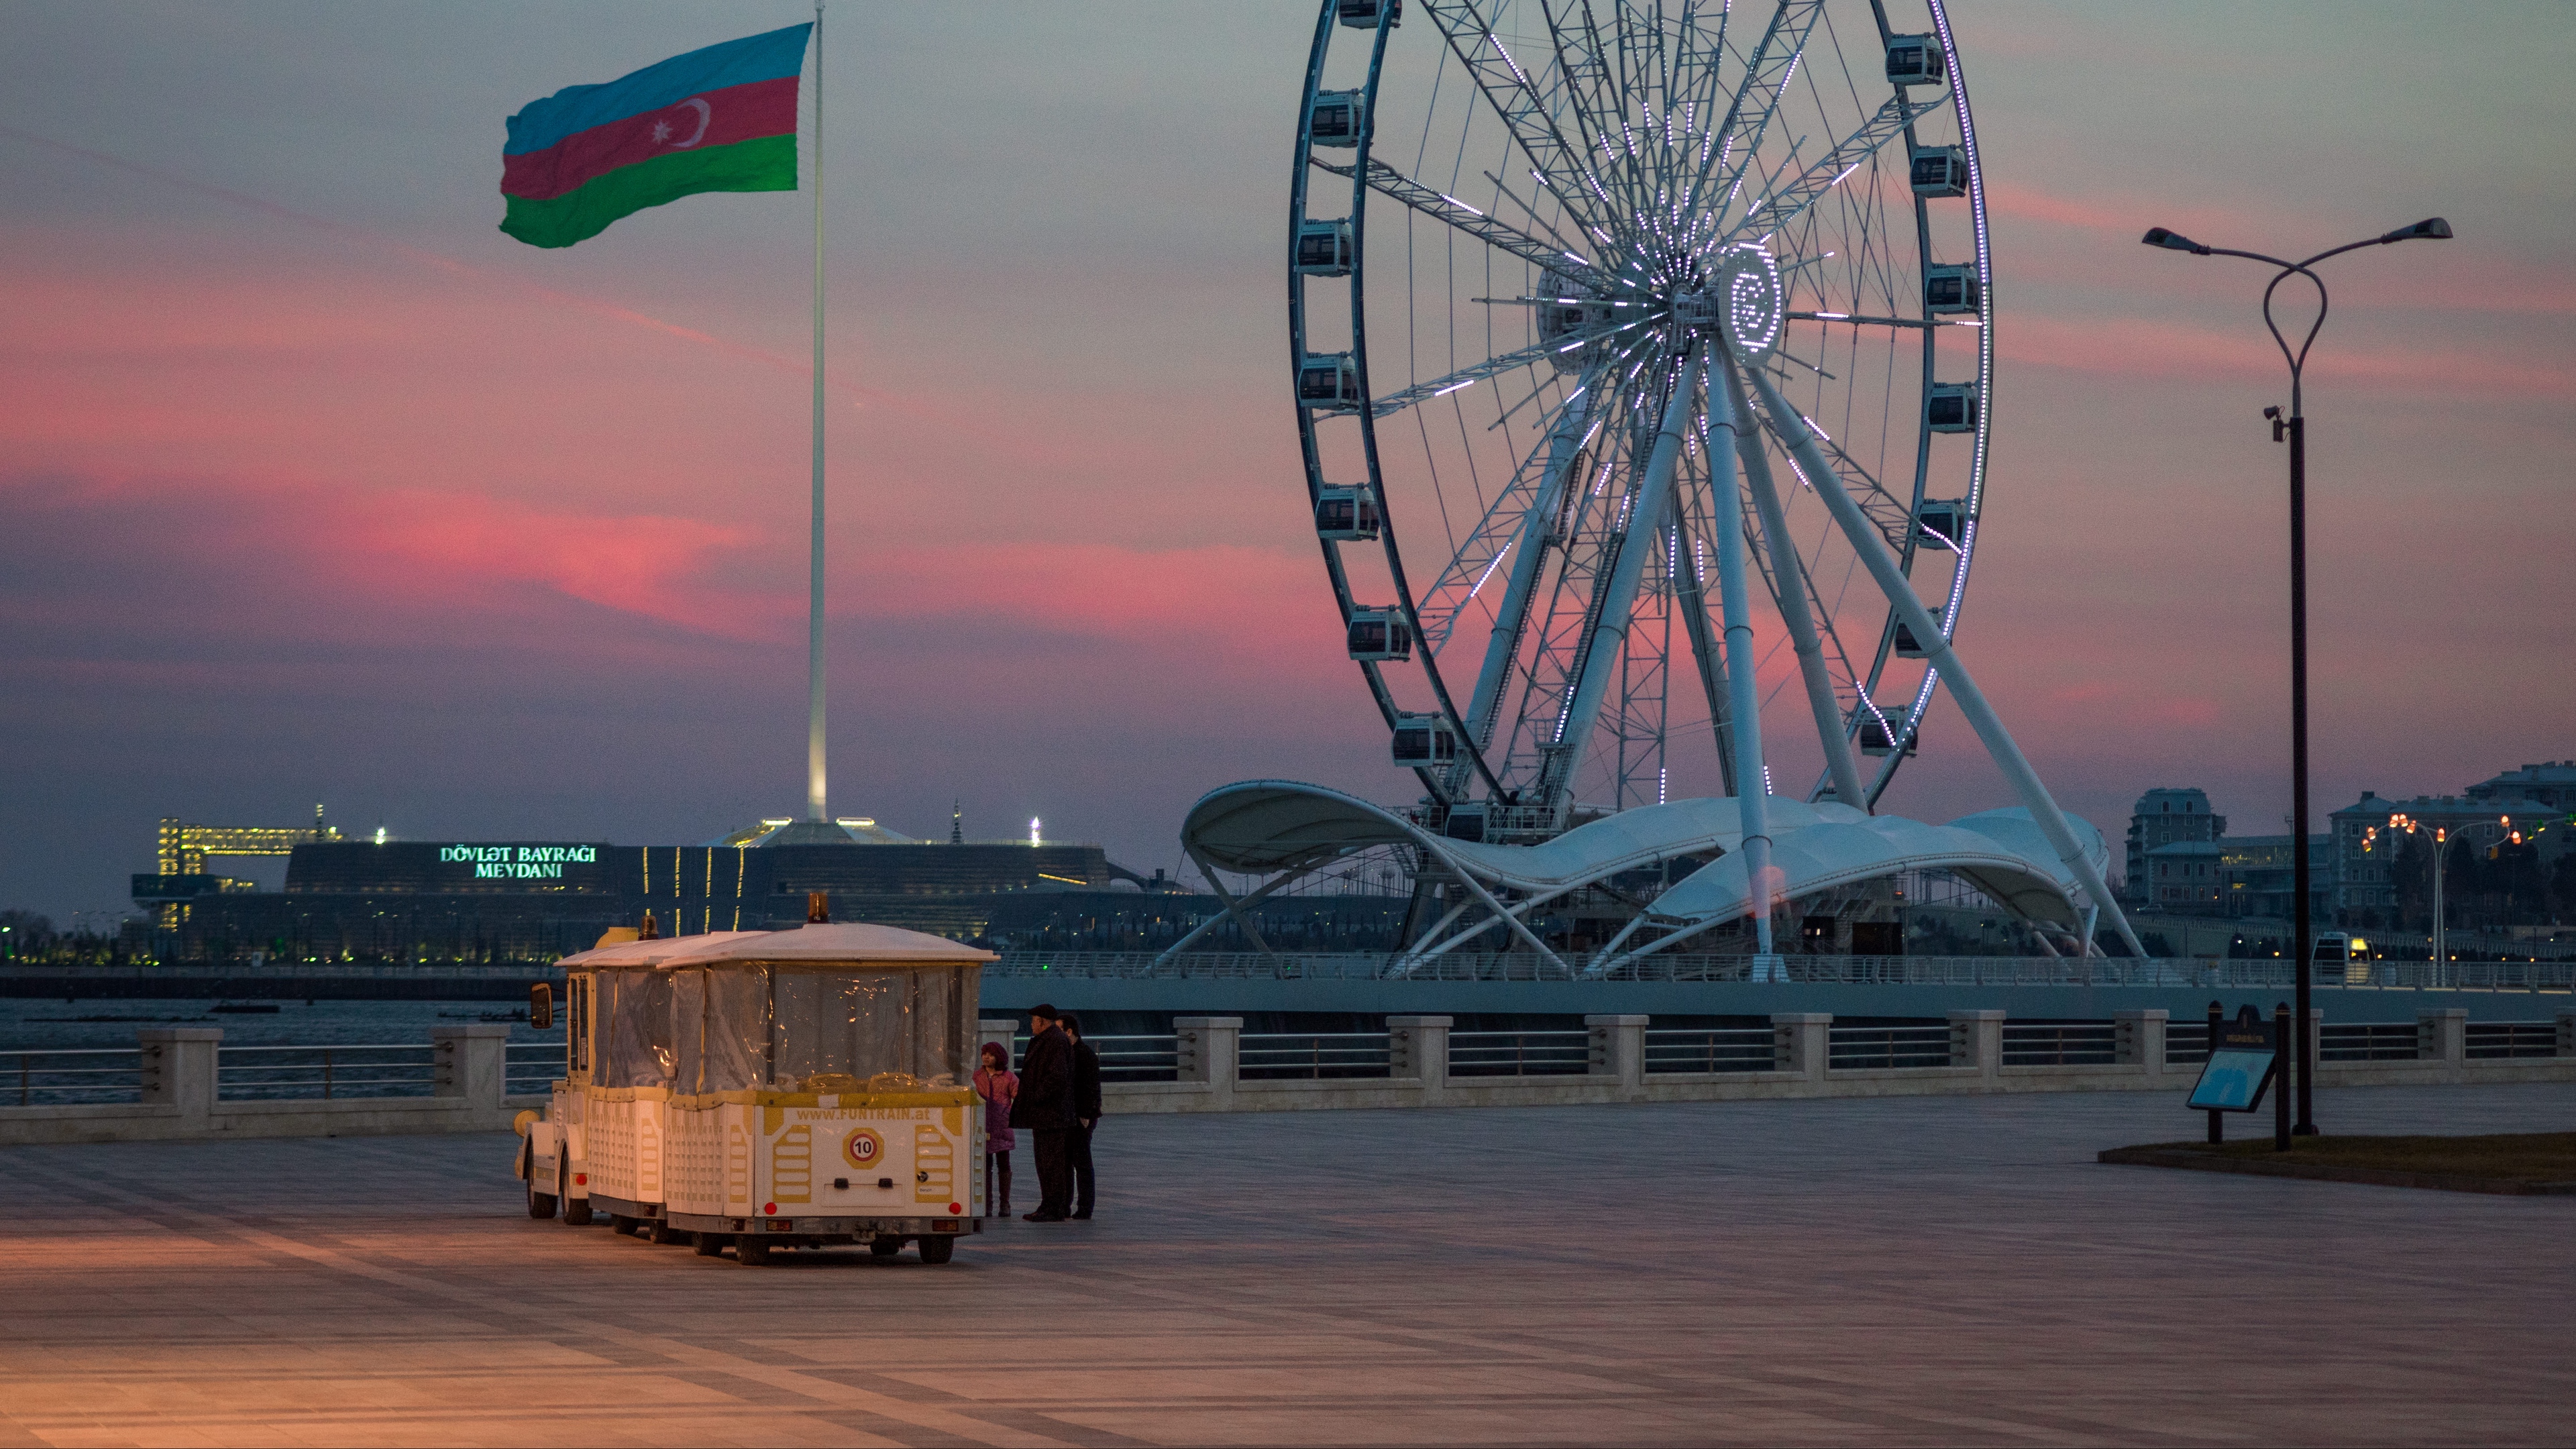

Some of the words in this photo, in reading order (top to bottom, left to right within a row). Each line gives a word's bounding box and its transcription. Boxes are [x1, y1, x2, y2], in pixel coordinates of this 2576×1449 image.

[440, 844, 512, 862] DÖVLƏT
[518, 845, 596, 862] BAYRAĞI
[474, 863, 563, 878] MEYDANI
[797, 1108, 930, 1120] www.FUNTRAIN.at
[855, 1141, 872, 1154] 10
